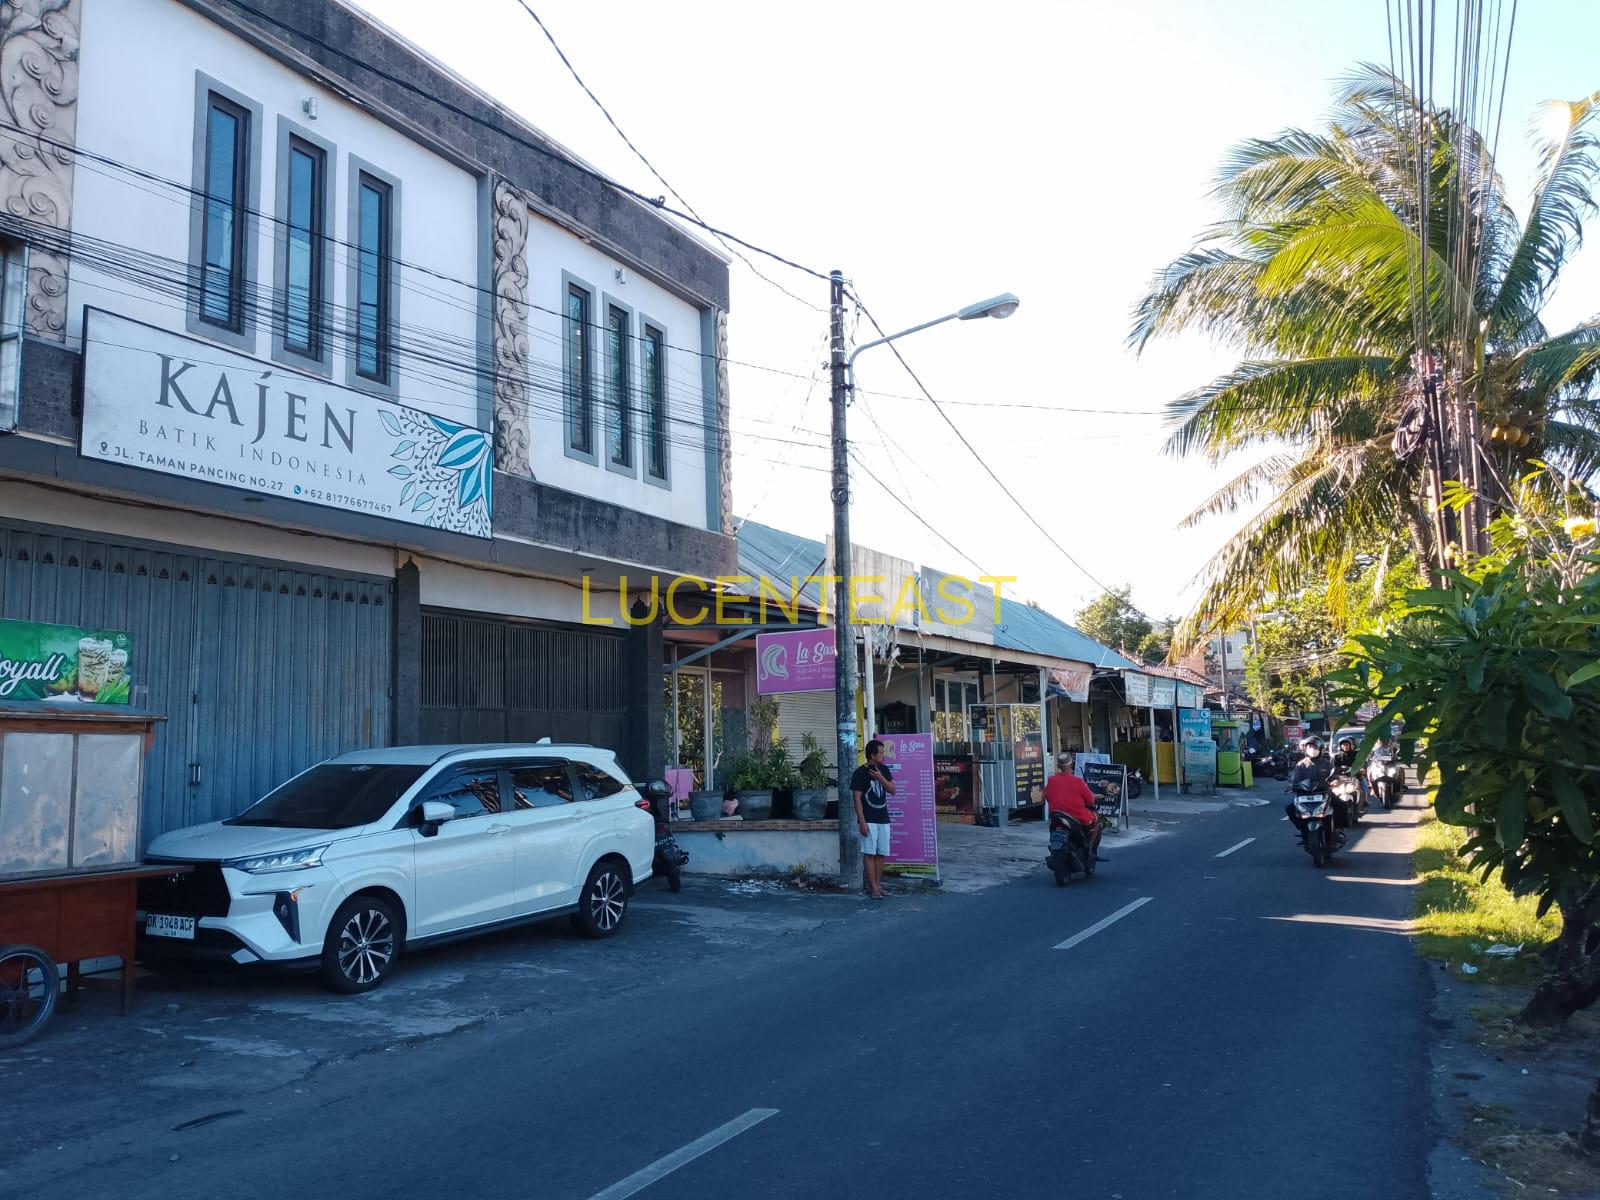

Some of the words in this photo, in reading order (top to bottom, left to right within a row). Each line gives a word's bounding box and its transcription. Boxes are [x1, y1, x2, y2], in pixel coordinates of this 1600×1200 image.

[155, 353, 358, 454] KAJEN
[114, 446, 134, 460] JL.
[138, 451, 186, 471] TAMAN
[190, 463, 246, 483] PANCING
[249, 475, 284, 491] NO.27
[139, 419, 217, 452] BATIK
[240, 444, 366, 486] INDONESIA
[304, 488, 323, 501] +62
[795, 641, 809, 665] La
[0, 654, 65, 696] oyall
